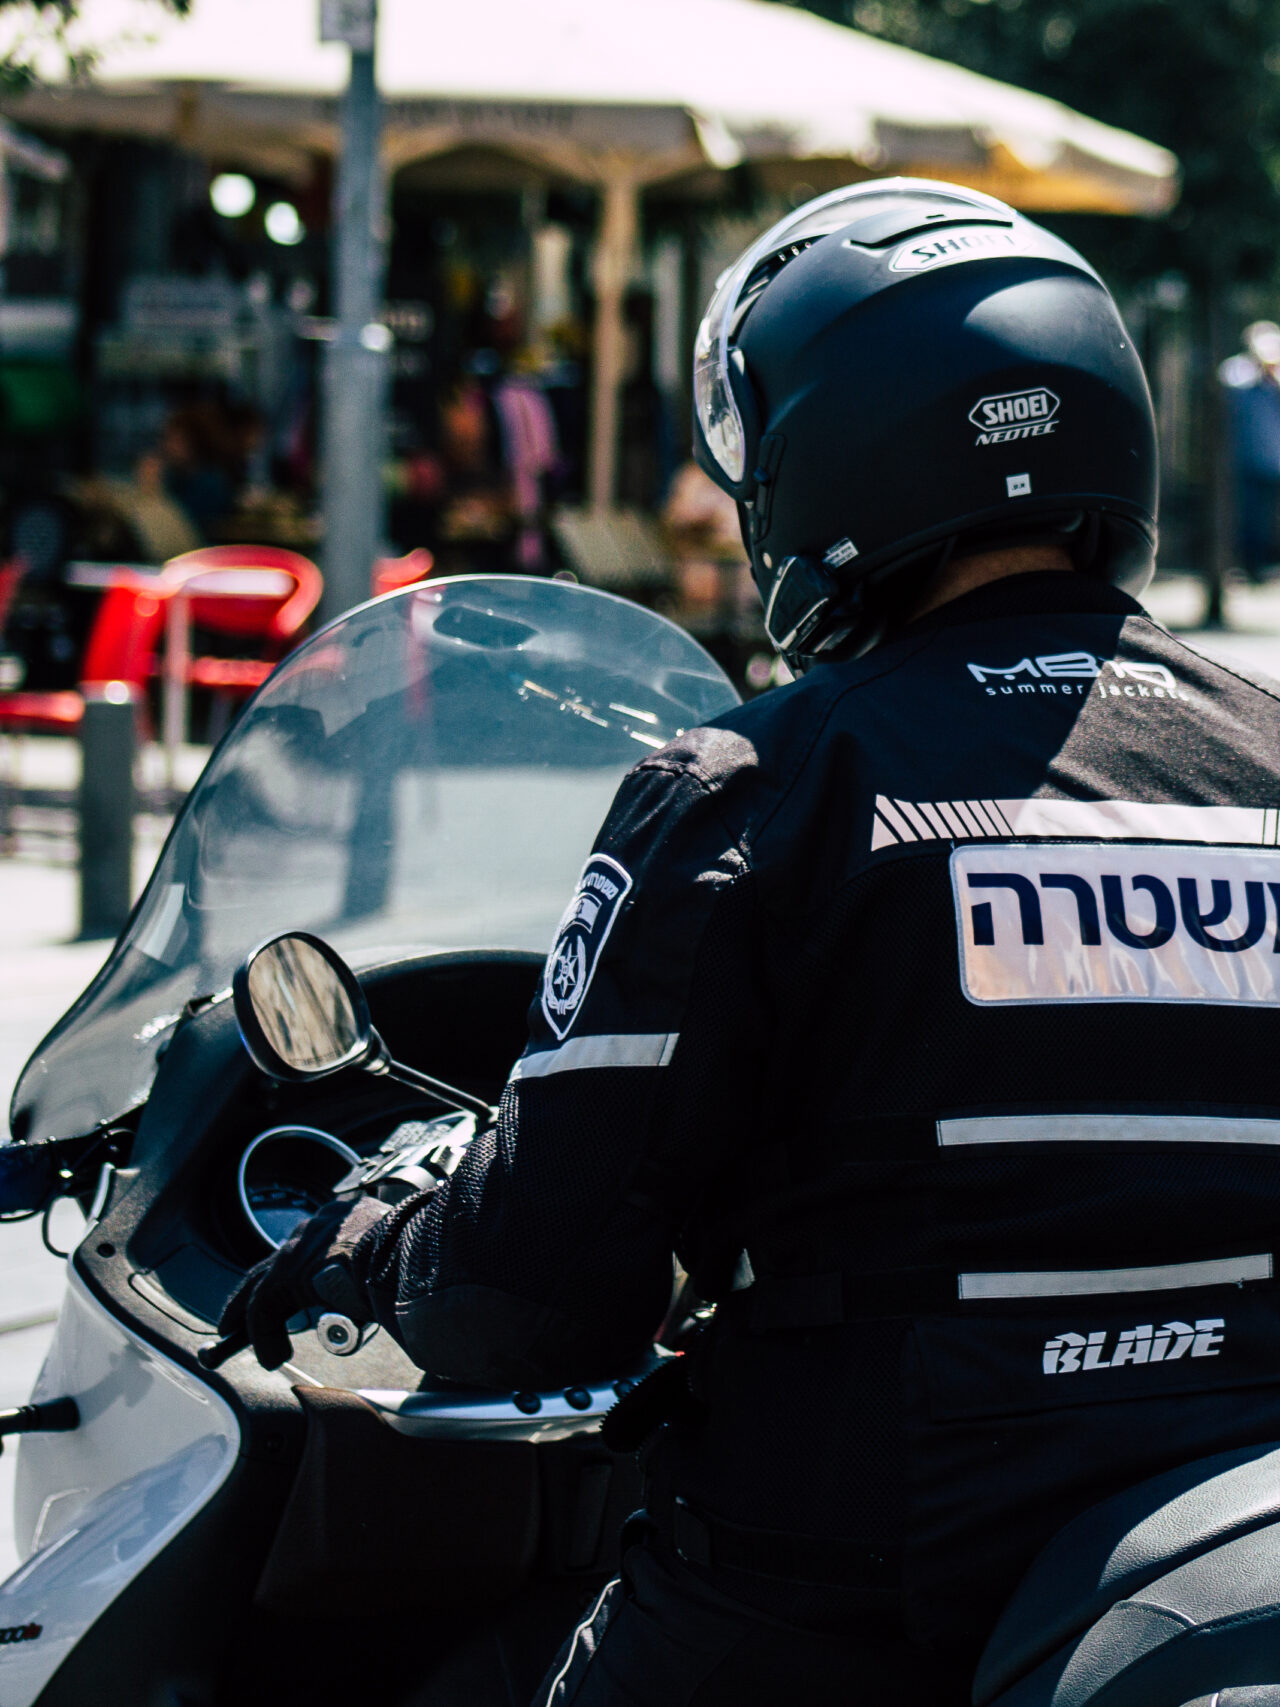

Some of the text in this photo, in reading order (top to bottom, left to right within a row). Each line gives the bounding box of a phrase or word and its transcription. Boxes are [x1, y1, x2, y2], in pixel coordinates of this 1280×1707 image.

[982, 393, 1049, 426] SHOEI
[975, 420, 1060, 447] NEOTEC
[985, 682, 1084, 697] summer
[1042, 1318, 1226, 1375] BLADE
